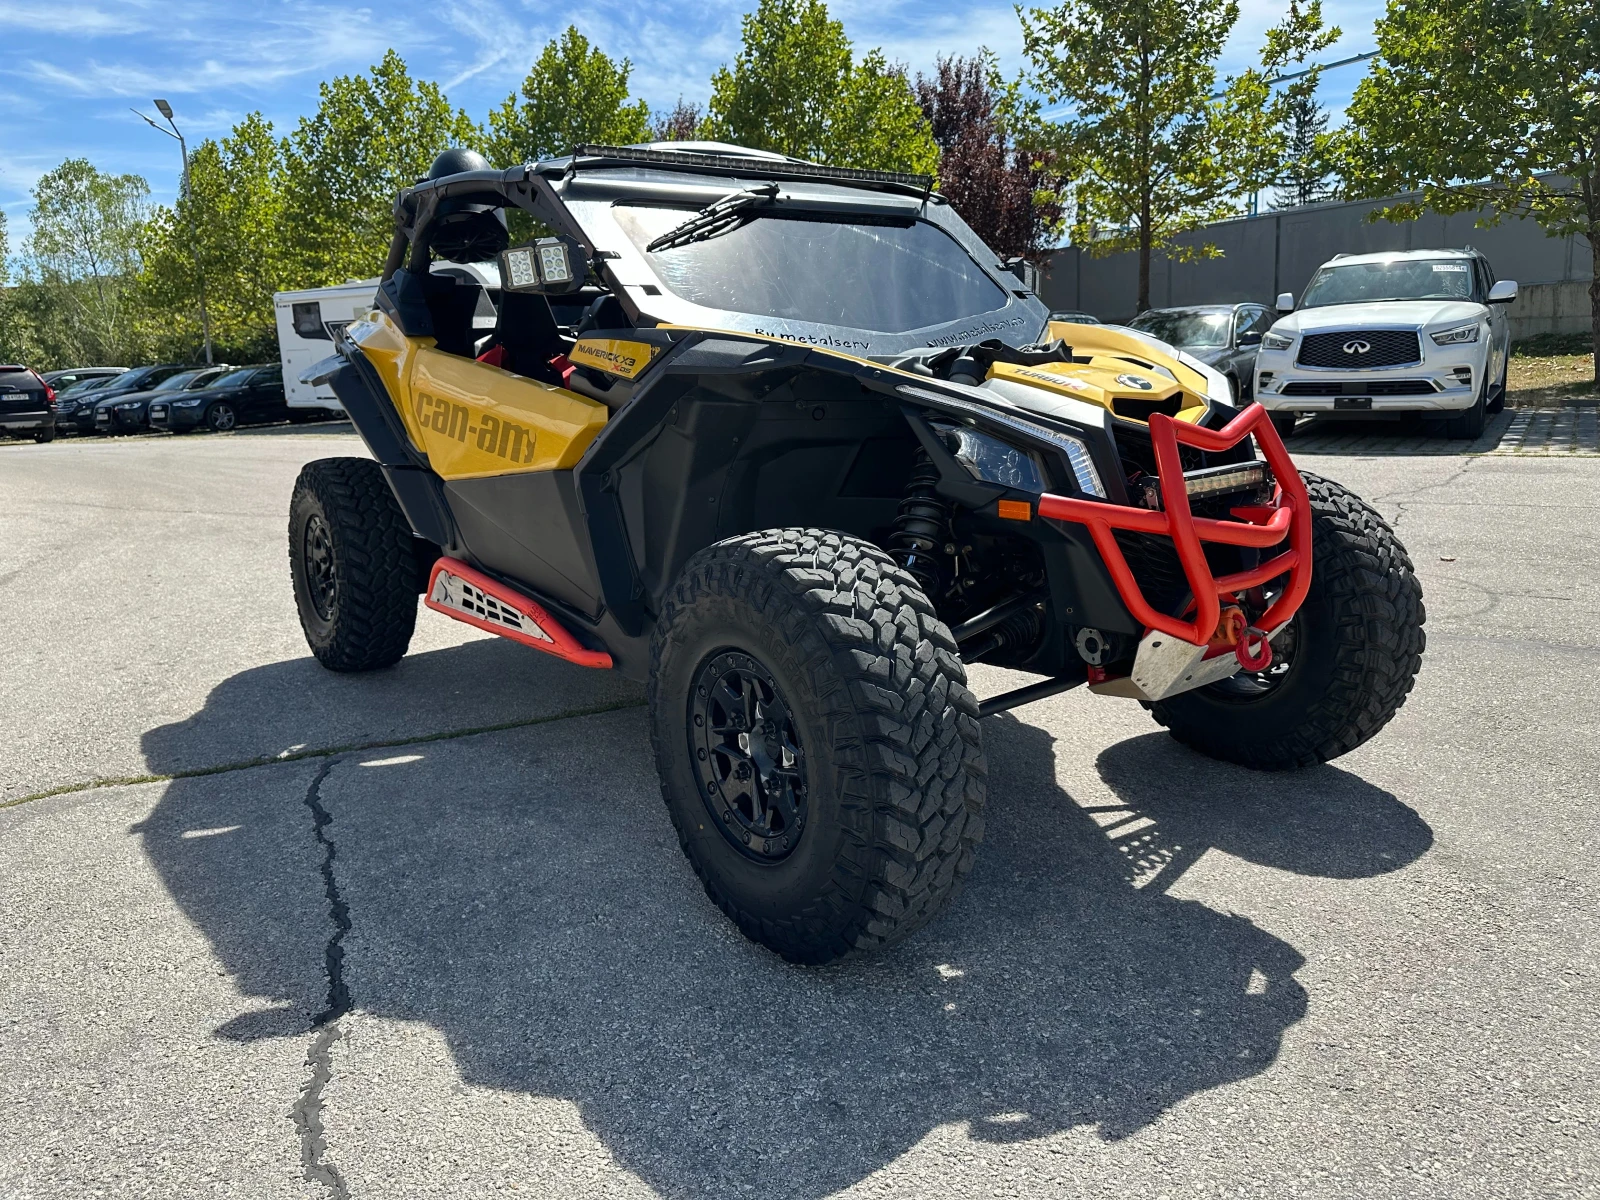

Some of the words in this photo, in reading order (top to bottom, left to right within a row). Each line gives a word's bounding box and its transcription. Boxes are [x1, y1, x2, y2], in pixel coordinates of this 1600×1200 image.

[780, 333, 870, 350] metalserv
[578, 343, 621, 363] MAVERICK
[620, 355, 637, 367] X3
[1014, 368, 1066, 385] TURBO
[415, 391, 537, 464] can-am
